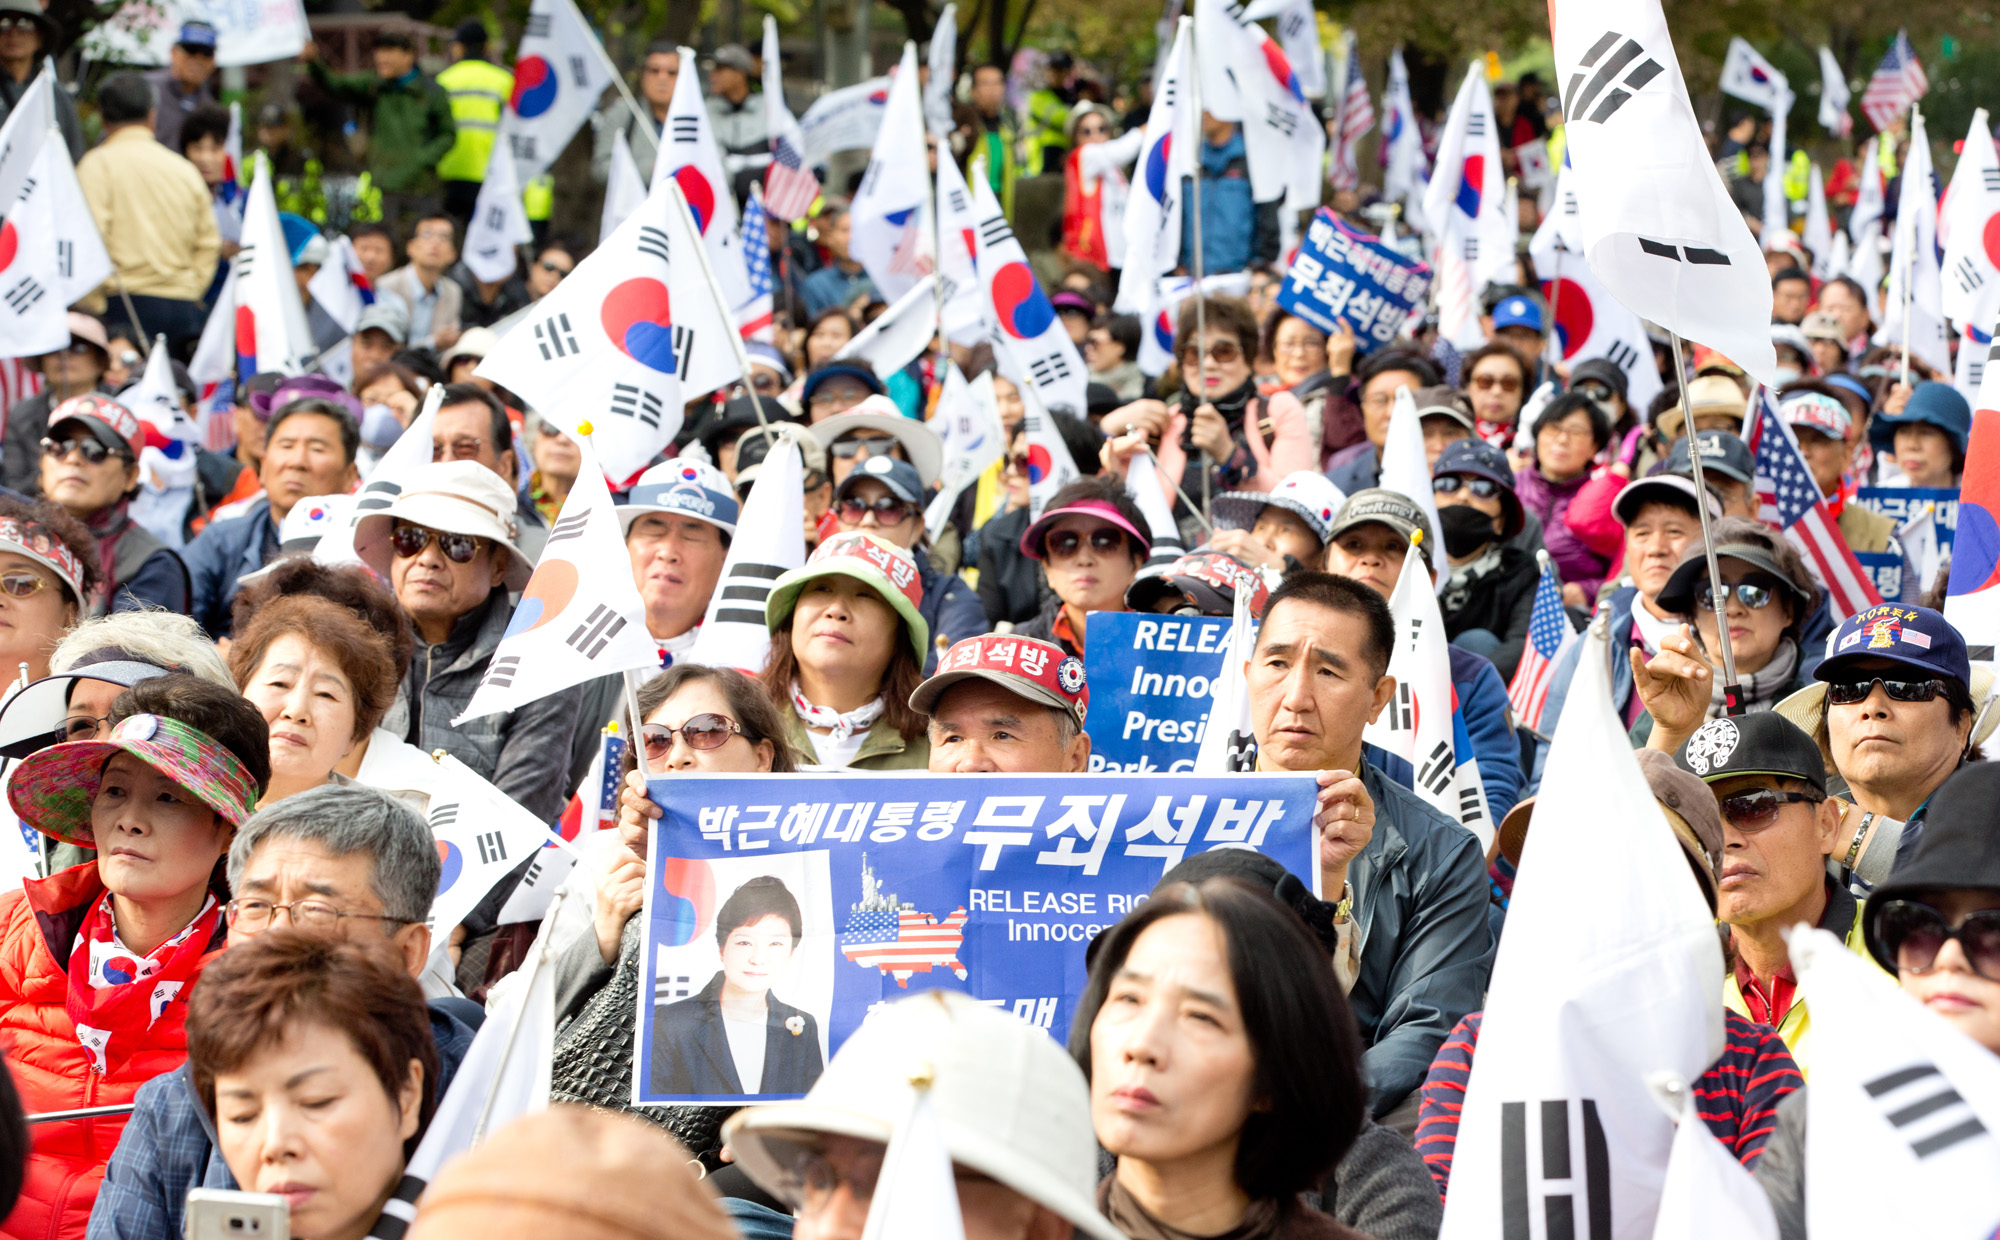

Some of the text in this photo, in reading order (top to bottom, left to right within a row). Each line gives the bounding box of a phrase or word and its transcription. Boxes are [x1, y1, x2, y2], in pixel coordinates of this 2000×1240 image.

[1288, 253, 1408, 342] 무죄석방
[866, 544, 915, 590] 석방
[1855, 606, 1919, 625] KOREA
[698, 794, 1287, 877] 박근혜대통령 무죄석방
[969, 889, 1097, 914] RELEASE
